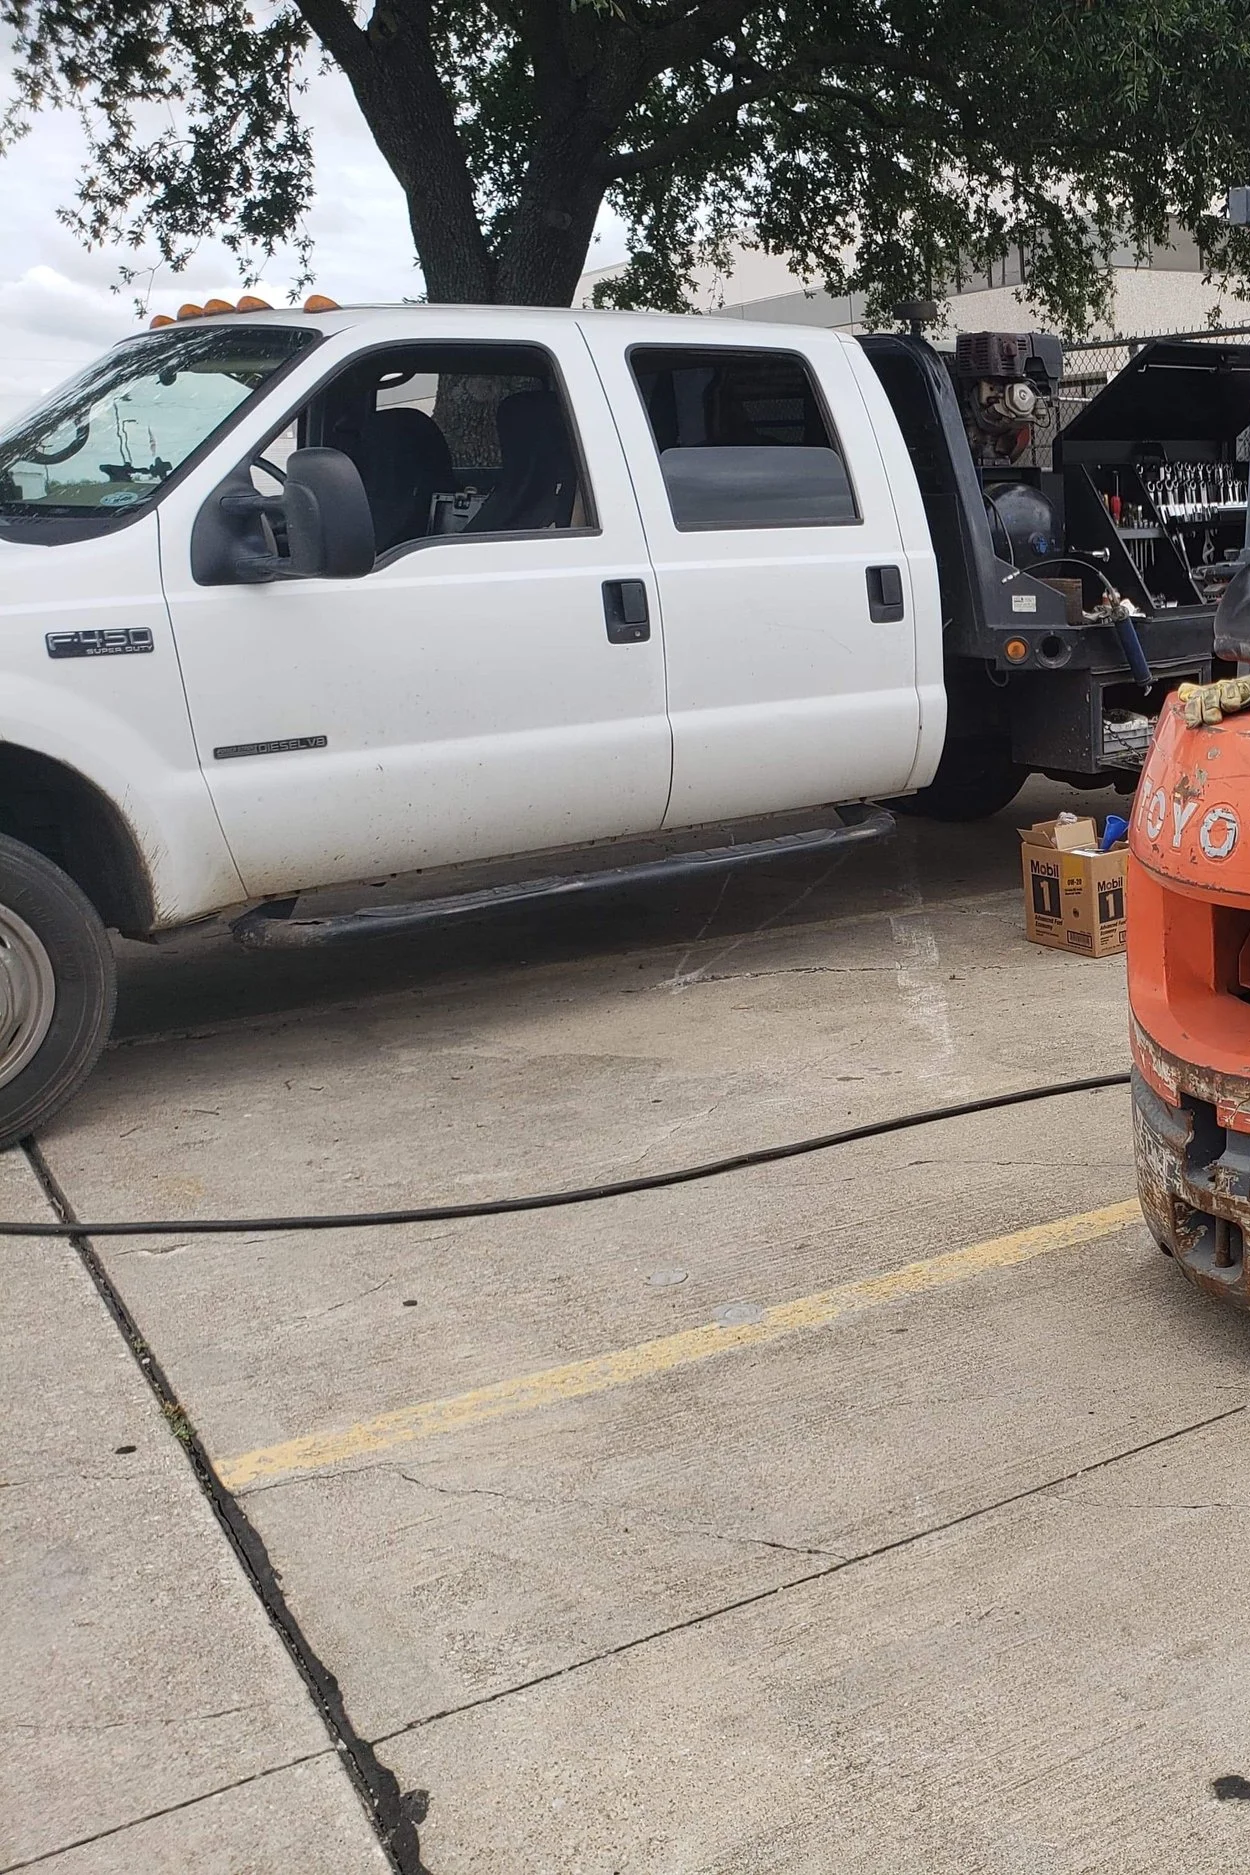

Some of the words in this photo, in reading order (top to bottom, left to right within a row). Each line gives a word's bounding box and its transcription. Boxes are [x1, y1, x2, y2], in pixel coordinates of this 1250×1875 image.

[86, 647, 122, 655] SUPER
[258, 739, 307, 753] DIESEL
[307, 737, 325, 747] V8
[1031, 860, 1059, 878] Mobil
[1097, 877, 1123, 892] Mobil
[1040, 880, 1051, 912] 1
[1106, 893, 1115, 919] 1
